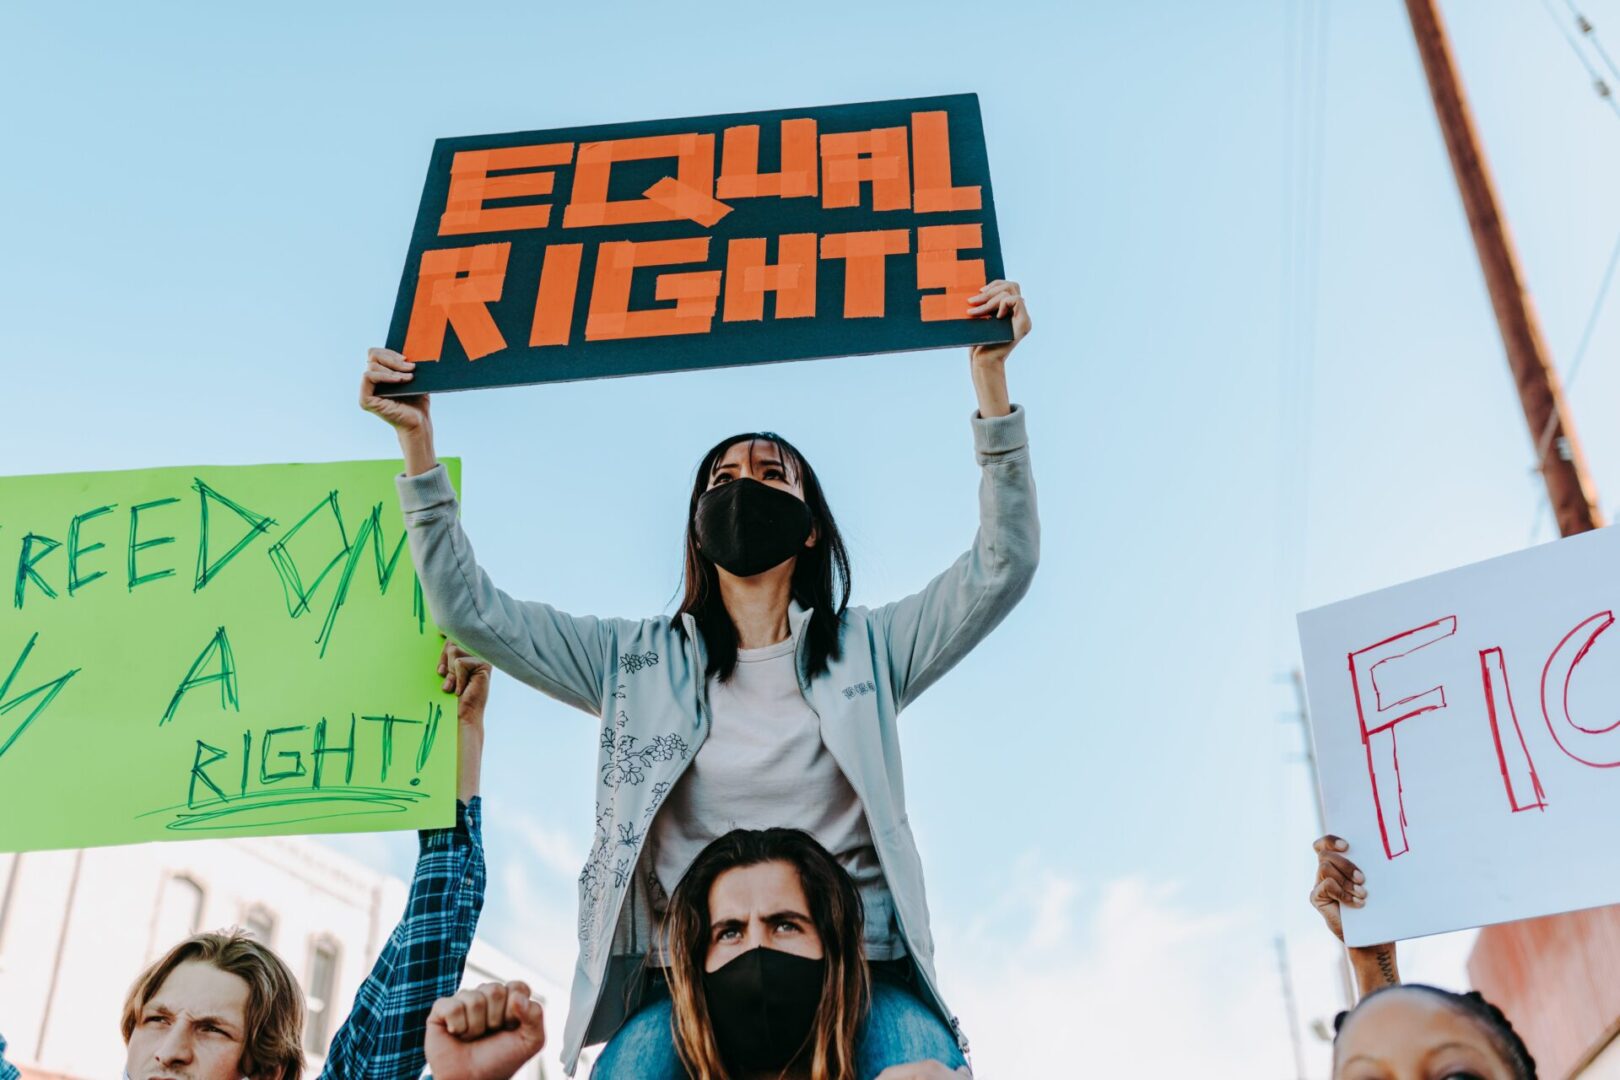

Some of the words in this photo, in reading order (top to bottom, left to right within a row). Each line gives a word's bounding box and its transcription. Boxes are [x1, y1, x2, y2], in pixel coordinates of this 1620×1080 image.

[437, 111, 982, 236] EQUAL
[402, 223, 990, 363] RIGHTS
[0, 477, 427, 659] REEDOM
[159, 625, 240, 727] A
[187, 702, 442, 810] RIGHT!
